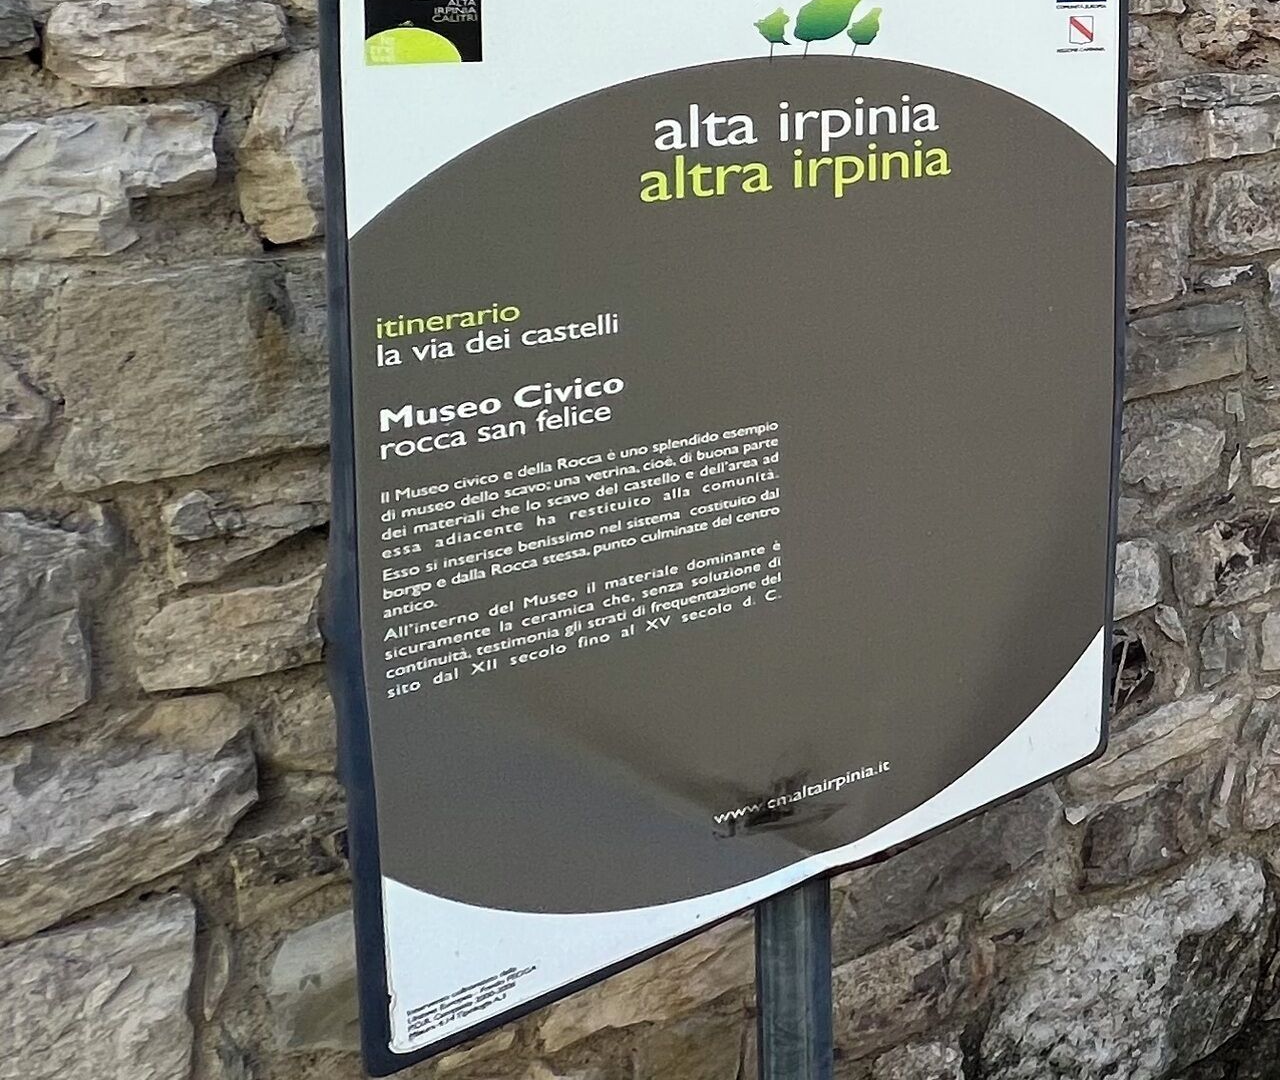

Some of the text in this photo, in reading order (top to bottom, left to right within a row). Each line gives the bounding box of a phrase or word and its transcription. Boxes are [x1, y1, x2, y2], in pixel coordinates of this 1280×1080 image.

[432, 14, 478, 22] CALITRI
[653, 94, 939, 152] alta irpinia
[639, 140, 951, 202] altra irpinia
[376, 303, 521, 339] itinerario
[377, 313, 618, 367] la via dei castelli
[379, 378, 625, 432] Museo Civico
[380, 406, 611, 460] rocca san felice
[381, 421, 779, 504] Il Museo civico e della Rocca è uno splendido esempio
[381, 510, 395, 522] di
[402, 500, 455, 518] museo
[460, 490, 499, 506] dello
[554, 476, 580, 488] una
[679, 453, 692, 463] di
[697, 445, 738, 461] buona
[743, 438, 779, 455] parte
[381, 452, 779, 541] dei materiali che lo scavo del castello e dell'area ad
[381, 543, 422, 559] essa
[435, 521, 523, 548] adiacente
[536, 515, 556, 527] ha
[569, 496, 651, 520] restituito
[663, 487, 690, 501] alla
[382, 488, 780, 582] Esso si inserisce benissimo nel sistema costituito dal
[383, 581, 432, 600] borgo
[436, 578, 447, 588] e
[451, 568, 486, 585] dalla
[491, 557, 538, 576] Rocca
[593, 537, 637, 557] punto
[641, 522, 709, 543] culminate
[712, 514, 732, 528] del
[736, 506, 780, 523] centro
[383, 540, 781, 642] All'interno del Museo il materiale dominante è
[385, 627, 491, 661] sicuramente
[500, 620, 513, 632] la
[521, 600, 594, 627] ceramica
[642, 580, 684, 598] senza
[691, 563, 761, 587] soluzione
[768, 556, 781, 568] di
[477, 626, 560, 656] testimonia
[565, 619, 582, 637] gli
[588, 610, 627, 629] strati
[632, 605, 645, 617] di
[650, 581, 757, 613] frequentazione
[762, 572, 781, 586] del
[388, 680, 421, 699] sito
[433, 668, 459, 684] dal
[470, 658, 497, 675] XII
[510, 643, 567, 665] secolo
[578, 635, 610, 648] fino
[621, 624, 634, 638] al
[646, 616, 670, 631] XV
[681, 602, 732, 623] secolo
[713, 760, 891, 824] wwwcmaltairpinia.it
